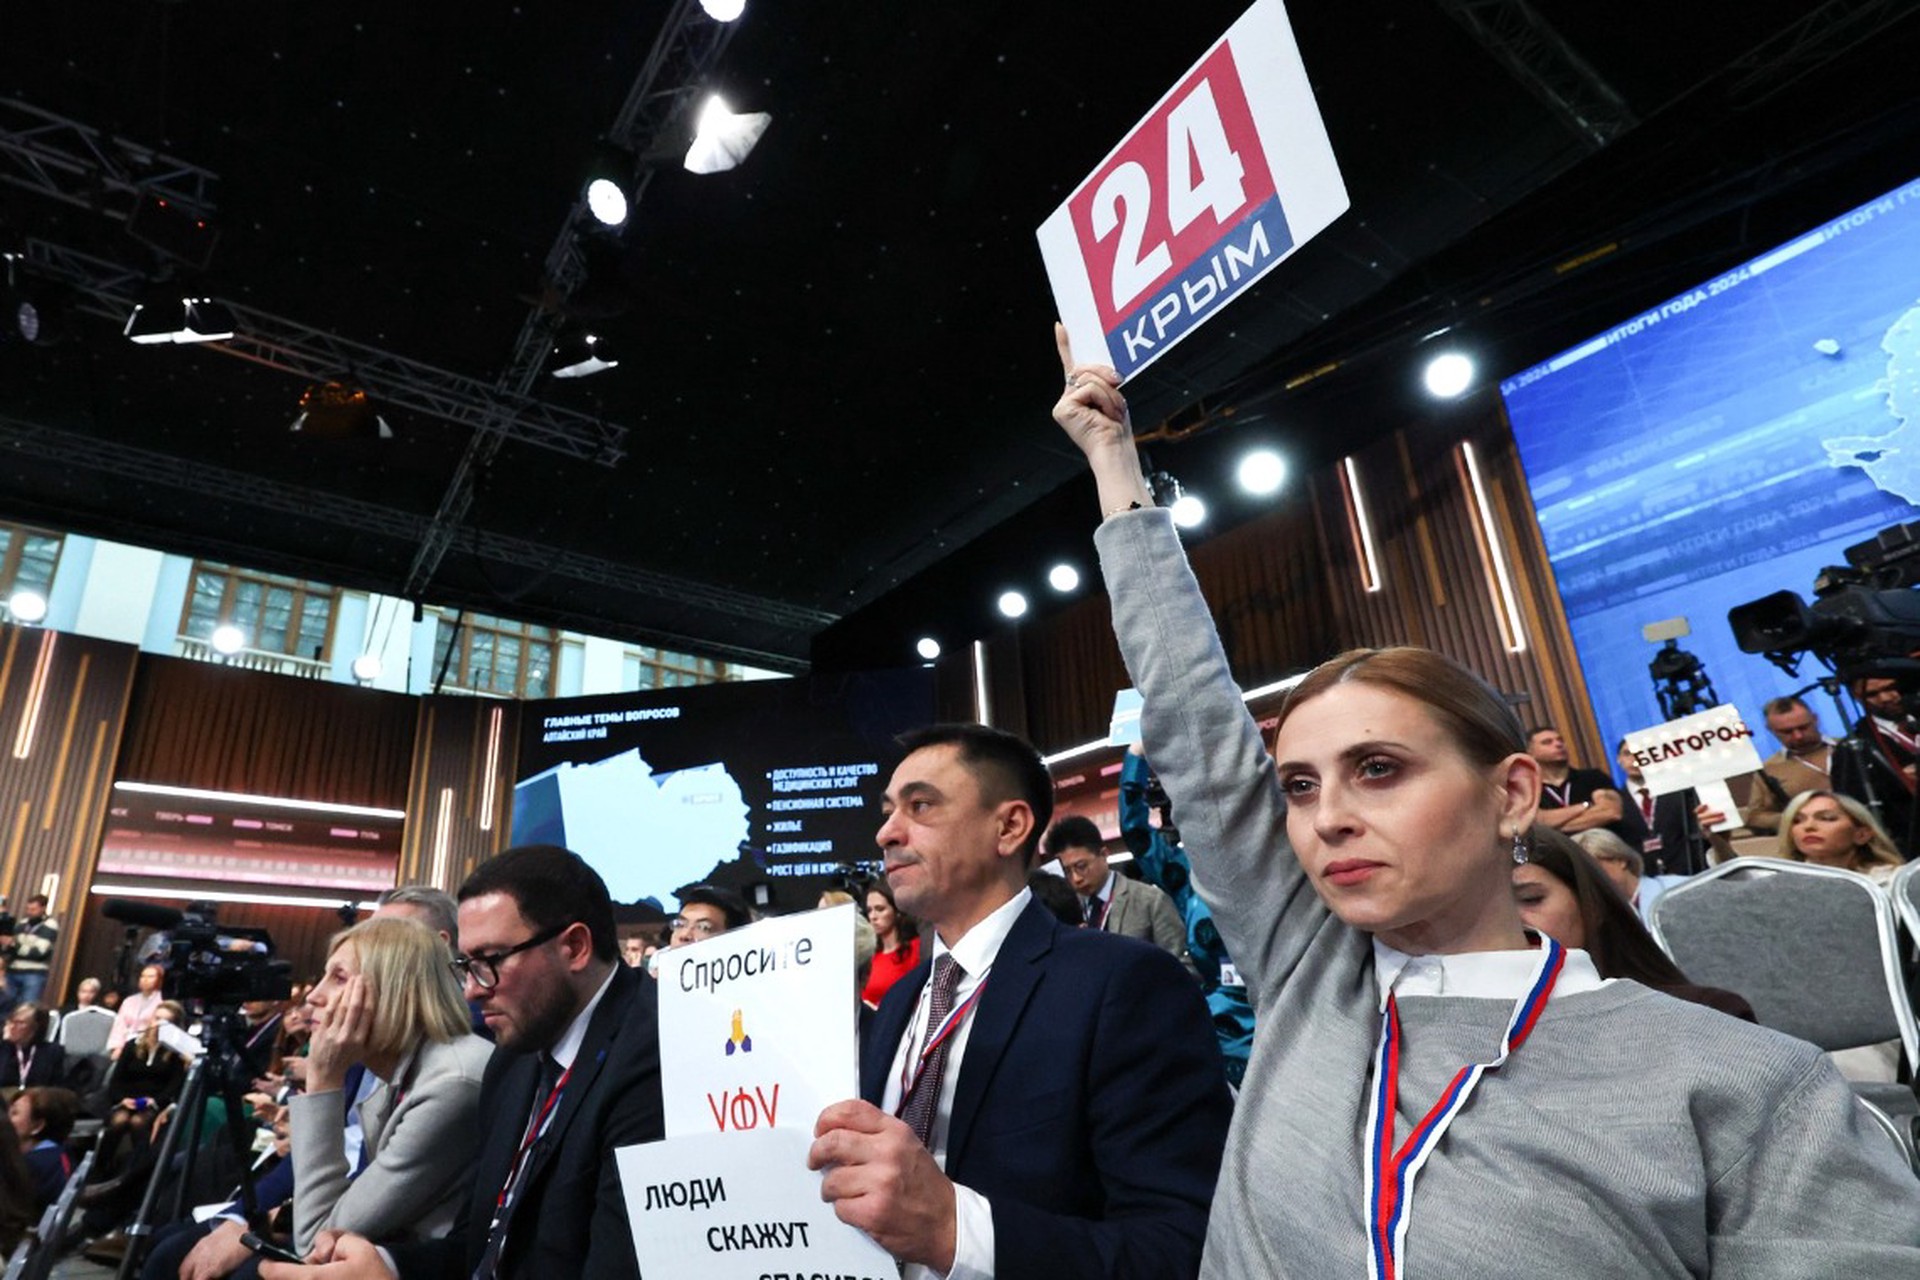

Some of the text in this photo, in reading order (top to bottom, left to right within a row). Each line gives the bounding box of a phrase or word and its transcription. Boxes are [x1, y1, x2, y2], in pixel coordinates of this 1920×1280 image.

[1091, 77, 1247, 313] 24
[1823, 198, 1895, 240] ИТОГИ
[1122, 220, 1271, 363] КРЫМ
[1606, 268, 1751, 345] ИТОГИ ГОДА 2024
[544, 707, 680, 728] ГЛАВНЫЕ ТЕМЫ ВОПРОСОВ
[587, 726, 607, 738] КРАЙ
[837, 763, 878, 776] КАЧЕСТВО
[825, 796, 864, 808] СИСТЕМА
[772, 865, 793, 876] РОСТ
[680, 937, 813, 993] Спросие
[645, 1176, 727, 1211] ЛЮДИ
[706, 1222, 809, 1252] СКАЖУТ
